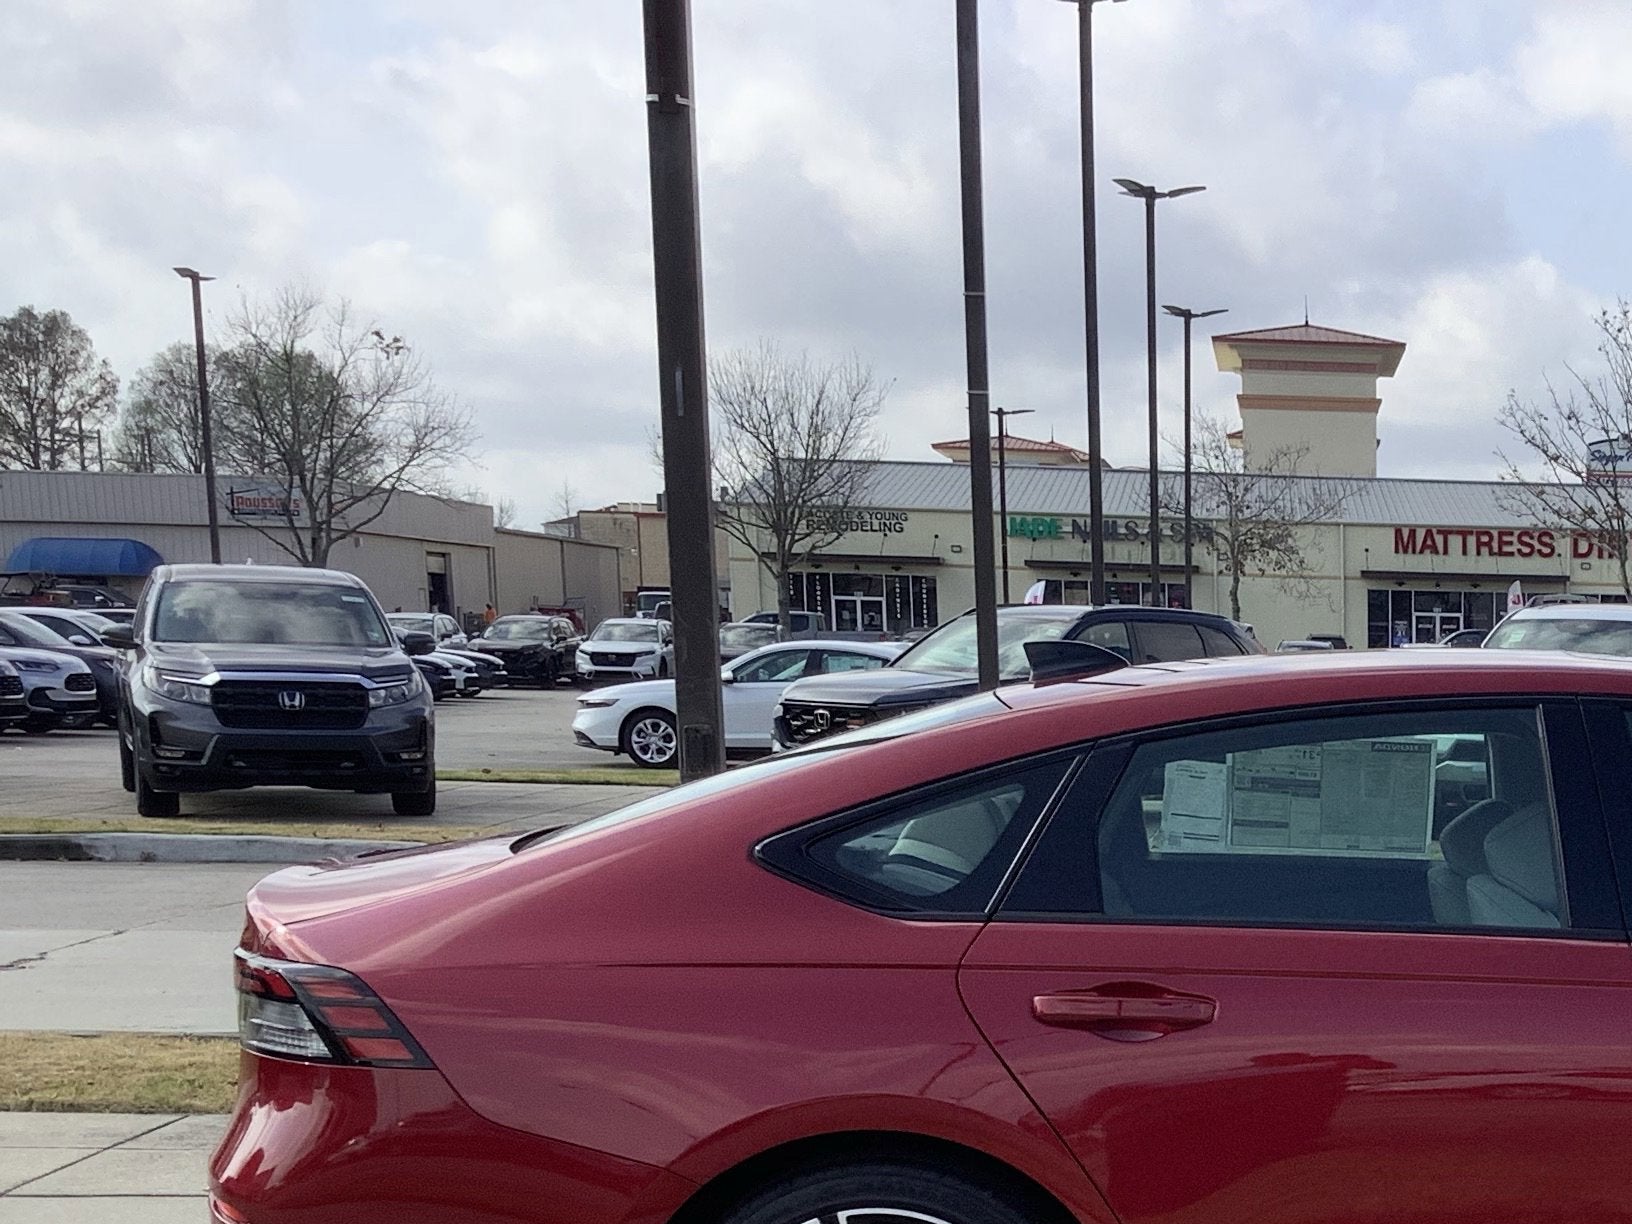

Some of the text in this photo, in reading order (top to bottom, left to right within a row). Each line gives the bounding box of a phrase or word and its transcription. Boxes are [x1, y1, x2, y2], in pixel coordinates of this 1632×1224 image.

[867, 511, 908, 521] YOUNG
[806, 519, 904, 533] REMODELING
[1072, 519, 1139, 541] NILS
[1393, 527, 1556, 558] MATTRESS
